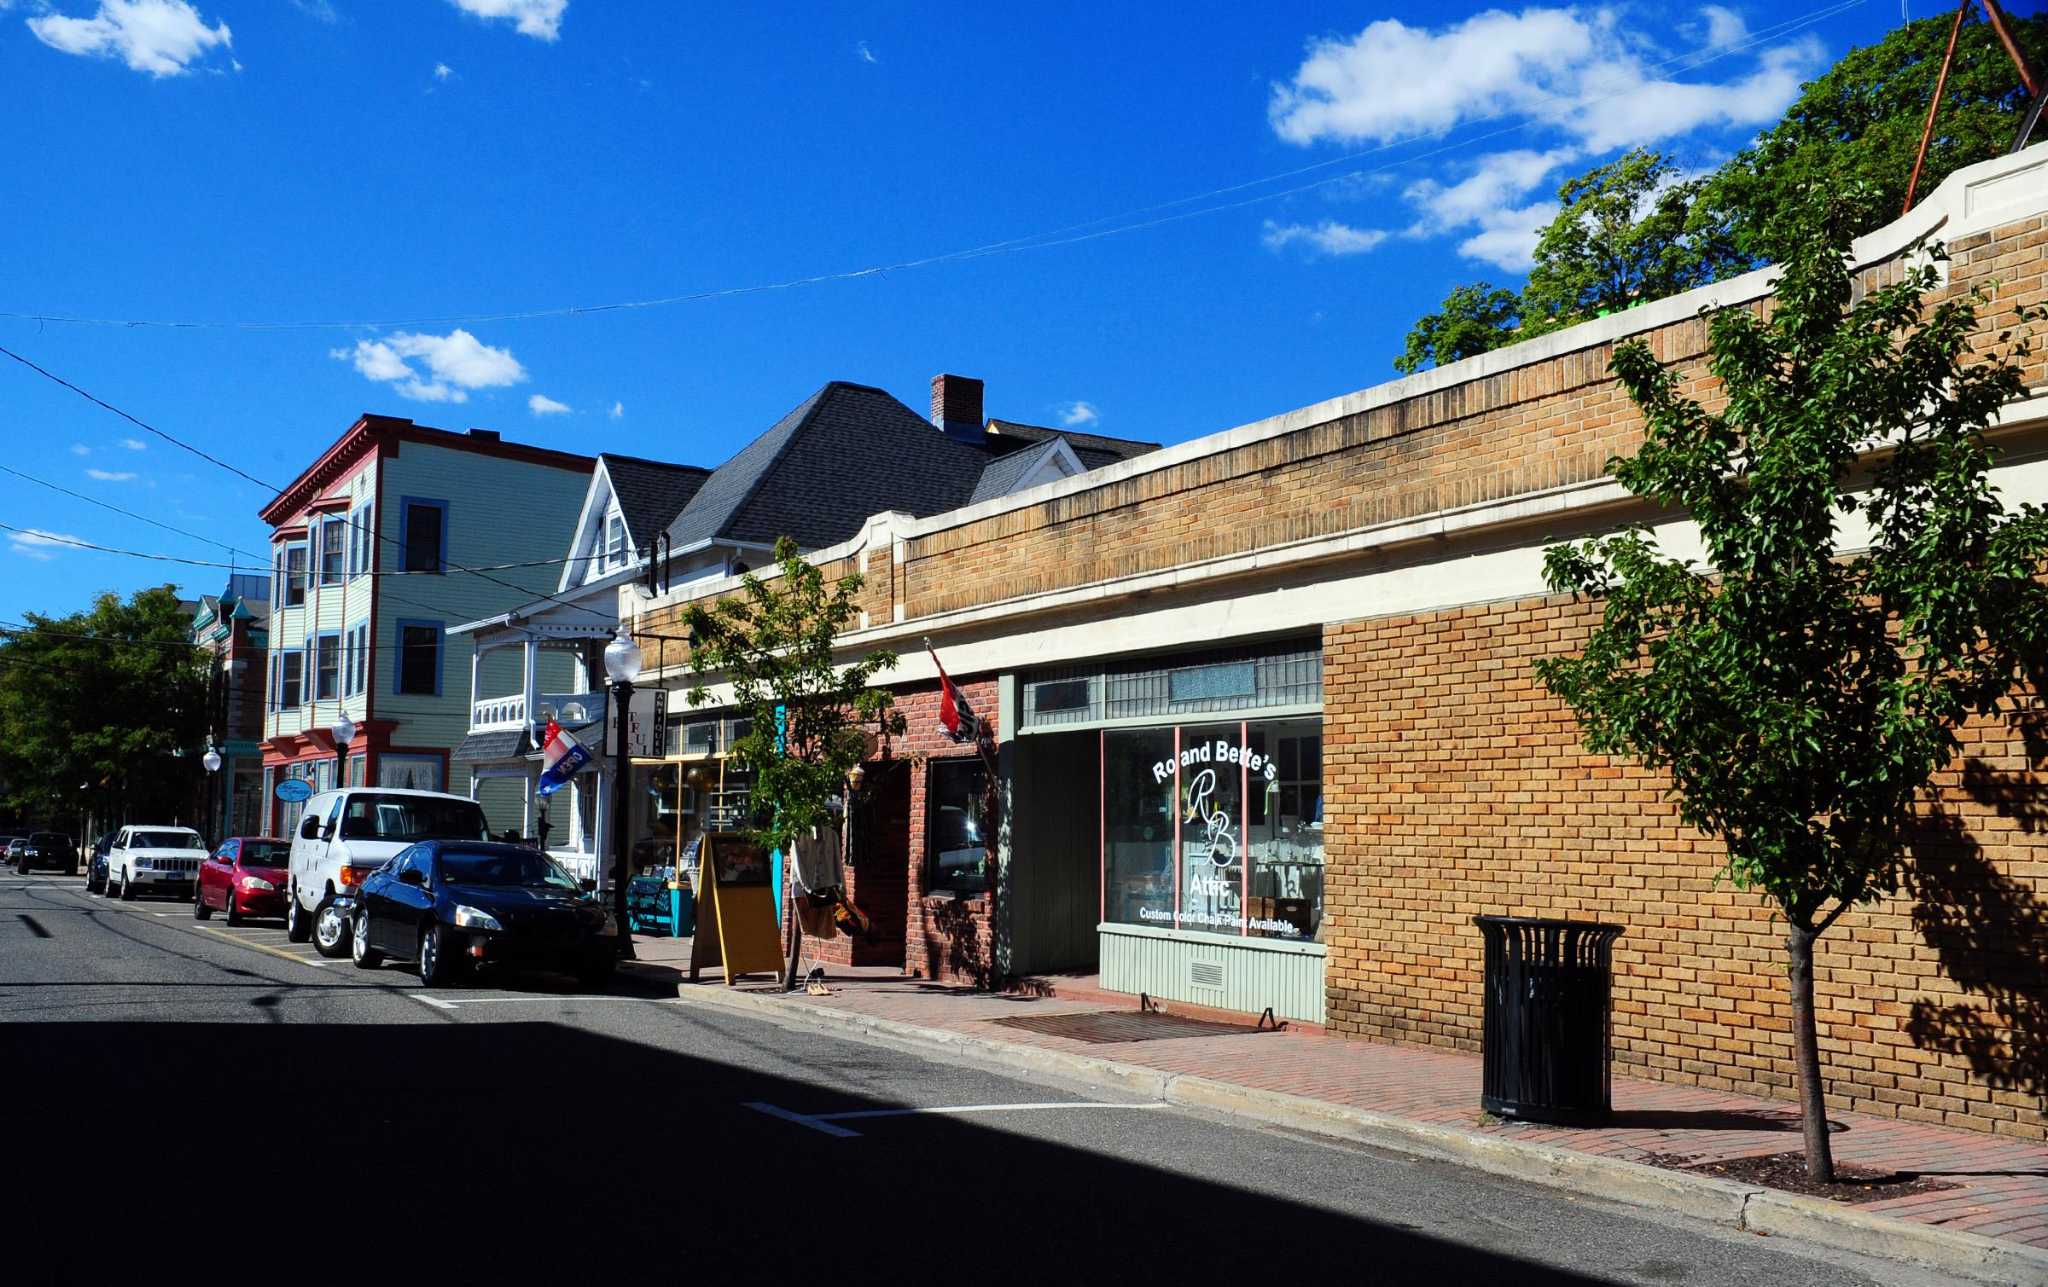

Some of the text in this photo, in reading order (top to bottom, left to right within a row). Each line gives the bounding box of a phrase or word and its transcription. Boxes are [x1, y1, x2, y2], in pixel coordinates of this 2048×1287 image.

[654, 693, 664, 755] ANTIQUES
[1152, 741, 1277, 784] Ro and Bette's
[1190, 874, 1231, 897] Attic
[1139, 907, 1294, 933] Custom Color Chalk Paint Available
